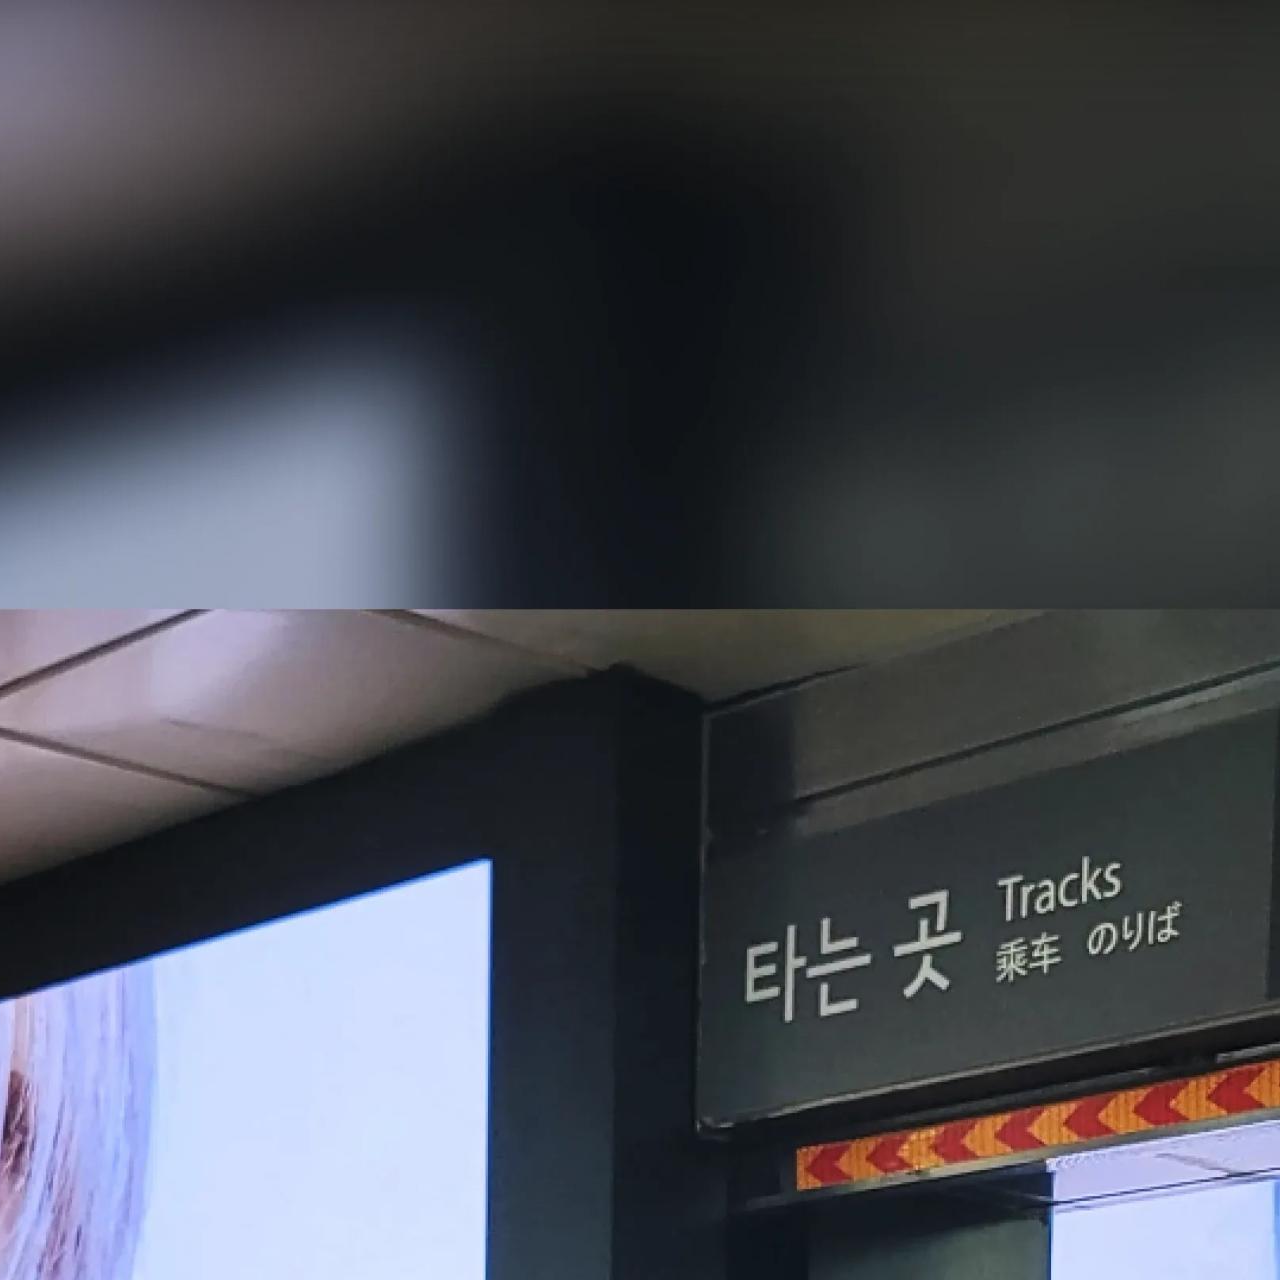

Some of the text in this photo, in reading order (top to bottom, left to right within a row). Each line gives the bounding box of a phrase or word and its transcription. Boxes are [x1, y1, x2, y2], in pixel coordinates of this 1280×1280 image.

[997, 856, 1122, 923] Tracks
[745, 889, 963, 1023] 타는 곳
[1086, 901, 1183, 956] のりば
